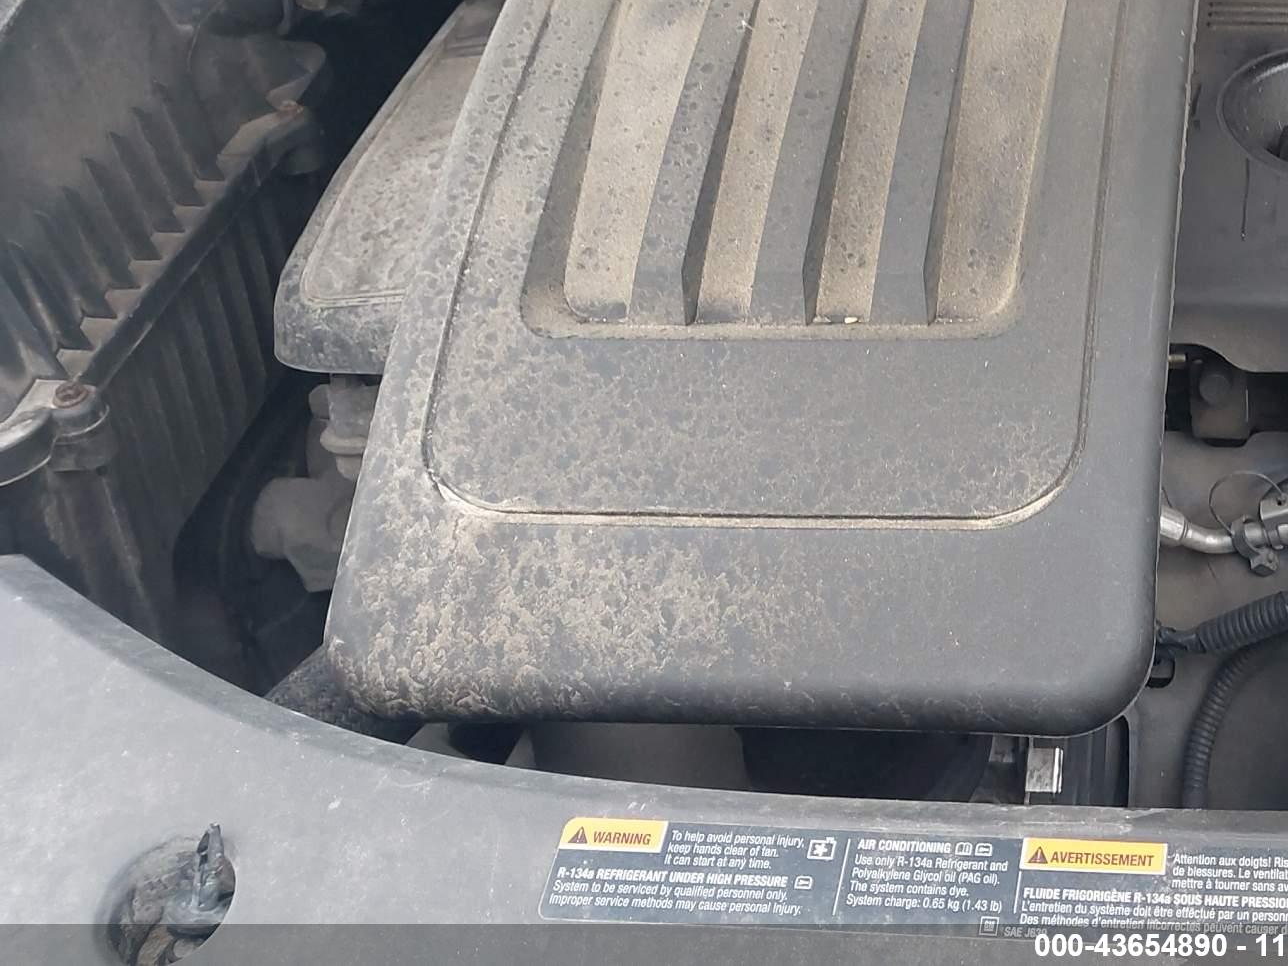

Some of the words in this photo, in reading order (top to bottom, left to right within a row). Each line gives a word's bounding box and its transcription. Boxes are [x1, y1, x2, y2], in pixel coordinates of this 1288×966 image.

[593, 831, 652, 845] WARNING
[672, 830, 682, 841] To
[684, 831, 704, 843] help
[706, 832, 732, 843] avoid
[734, 833, 775, 846] personal
[857, 839, 875, 850] AIR
[878, 840, 951, 854] CONDITIONING
[667, 842, 691, 855] keep
[693, 844, 721, 854] hands
[724, 844, 747, 855] clear
[750, 845, 761, 856] of
[676, 857, 690, 866] can
[693, 856, 714, 866] start
[717, 857, 728, 867] at
[728, 858, 746, 870] any
[749, 858, 772, 869] time.
[854, 854, 872, 865] Use
[874, 855, 895, 868] only
[897, 857, 933, 869] R-134a
[935, 858, 987, 872] Refrigerant
[990, 860, 1008, 872] and
[1050, 851, 1155, 867] AVERTISSEMENT
[1172, 853, 1216, 866] Attention
[1218, 857, 1237, 866] aux
[1239, 855, 1272, 870] doigts!
[557, 867, 594, 879] R-134a
[596, 869, 668, 883] REFRIGERANT
[669, 871, 704, 884] UNDER
[706, 873, 732, 885] HIGH
[734, 874, 788, 888] PRESSURE
[851, 867, 911, 882] Polyalkylene
[913, 870, 942, 883] Glycol
[944, 870, 956, 882] oil
[958, 871, 981, 885] (PAG
[1172, 866, 1185, 877] de
[1187, 867, 1236, 878] blessures.
[1238, 867, 1251, 878] Le
[553, 880, 589, 894] System
[591, 882, 601, 893] to
[603, 882, 616, 894] be
[618, 884, 658, 895] serviced
[660, 884, 671, 897] by
[674, 886, 716, 899] qualified
[717, 888, 764, 901] personnel
[766, 890, 787, 902] only.
[850, 880, 867, 892] The
[869, 882, 904, 894] system
[906, 883, 947, 895] contains
[949, 885, 969, 898] dye.
[1171, 879, 1203, 890] mettre
[1205, 879, 1212, 890] à
[1214, 880, 1249, 891] tourner
[1252, 882, 1275, 892] sans
[549, 893, 592, 907] Improper
[594, 895, 631, 907] service
[632, 897, 673, 909] methods
[675, 900, 697, 912] may
[698, 901, 727, 911] cause
[728, 901, 771, 914] personal
[846, 893, 882, 907] System
[884, 896, 921, 910] charge:
[923, 897, 945, 909] 0.65
[947, 899, 960, 912] kg
[962, 900, 988, 912] (1.43
[990, 900, 1002, 913] lb)
[1023, 887, 1061, 900] FLUIDE
[1062, 887, 1131, 903] FRIGORIGÈNE
[1133, 891, 1171, 904] R-134a
[1173, 893, 1203, 906] SOUS
[1204, 894, 1239, 907] HAUTE
[1021, 900, 1073, 914] L'entretien
[1075, 903, 1088, 915] du
[1089, 905, 1131, 919] système
[1133, 905, 1151, 917] doit
[1153, 905, 1173, 917] être
[1218, 910, 1235, 922] par
[1237, 911, 1249, 921] un
[1004, 926, 1023, 937] SAE
[1020, 914, 1039, 925] Des
[1041, 914, 1089, 926] méthodes
[1091, 916, 1145, 930] d'entretien
[1146, 918, 1201, 932] incorrectes
[1204, 922, 1244, 934] peuvent
[1246, 924, 1279, 935] causer
